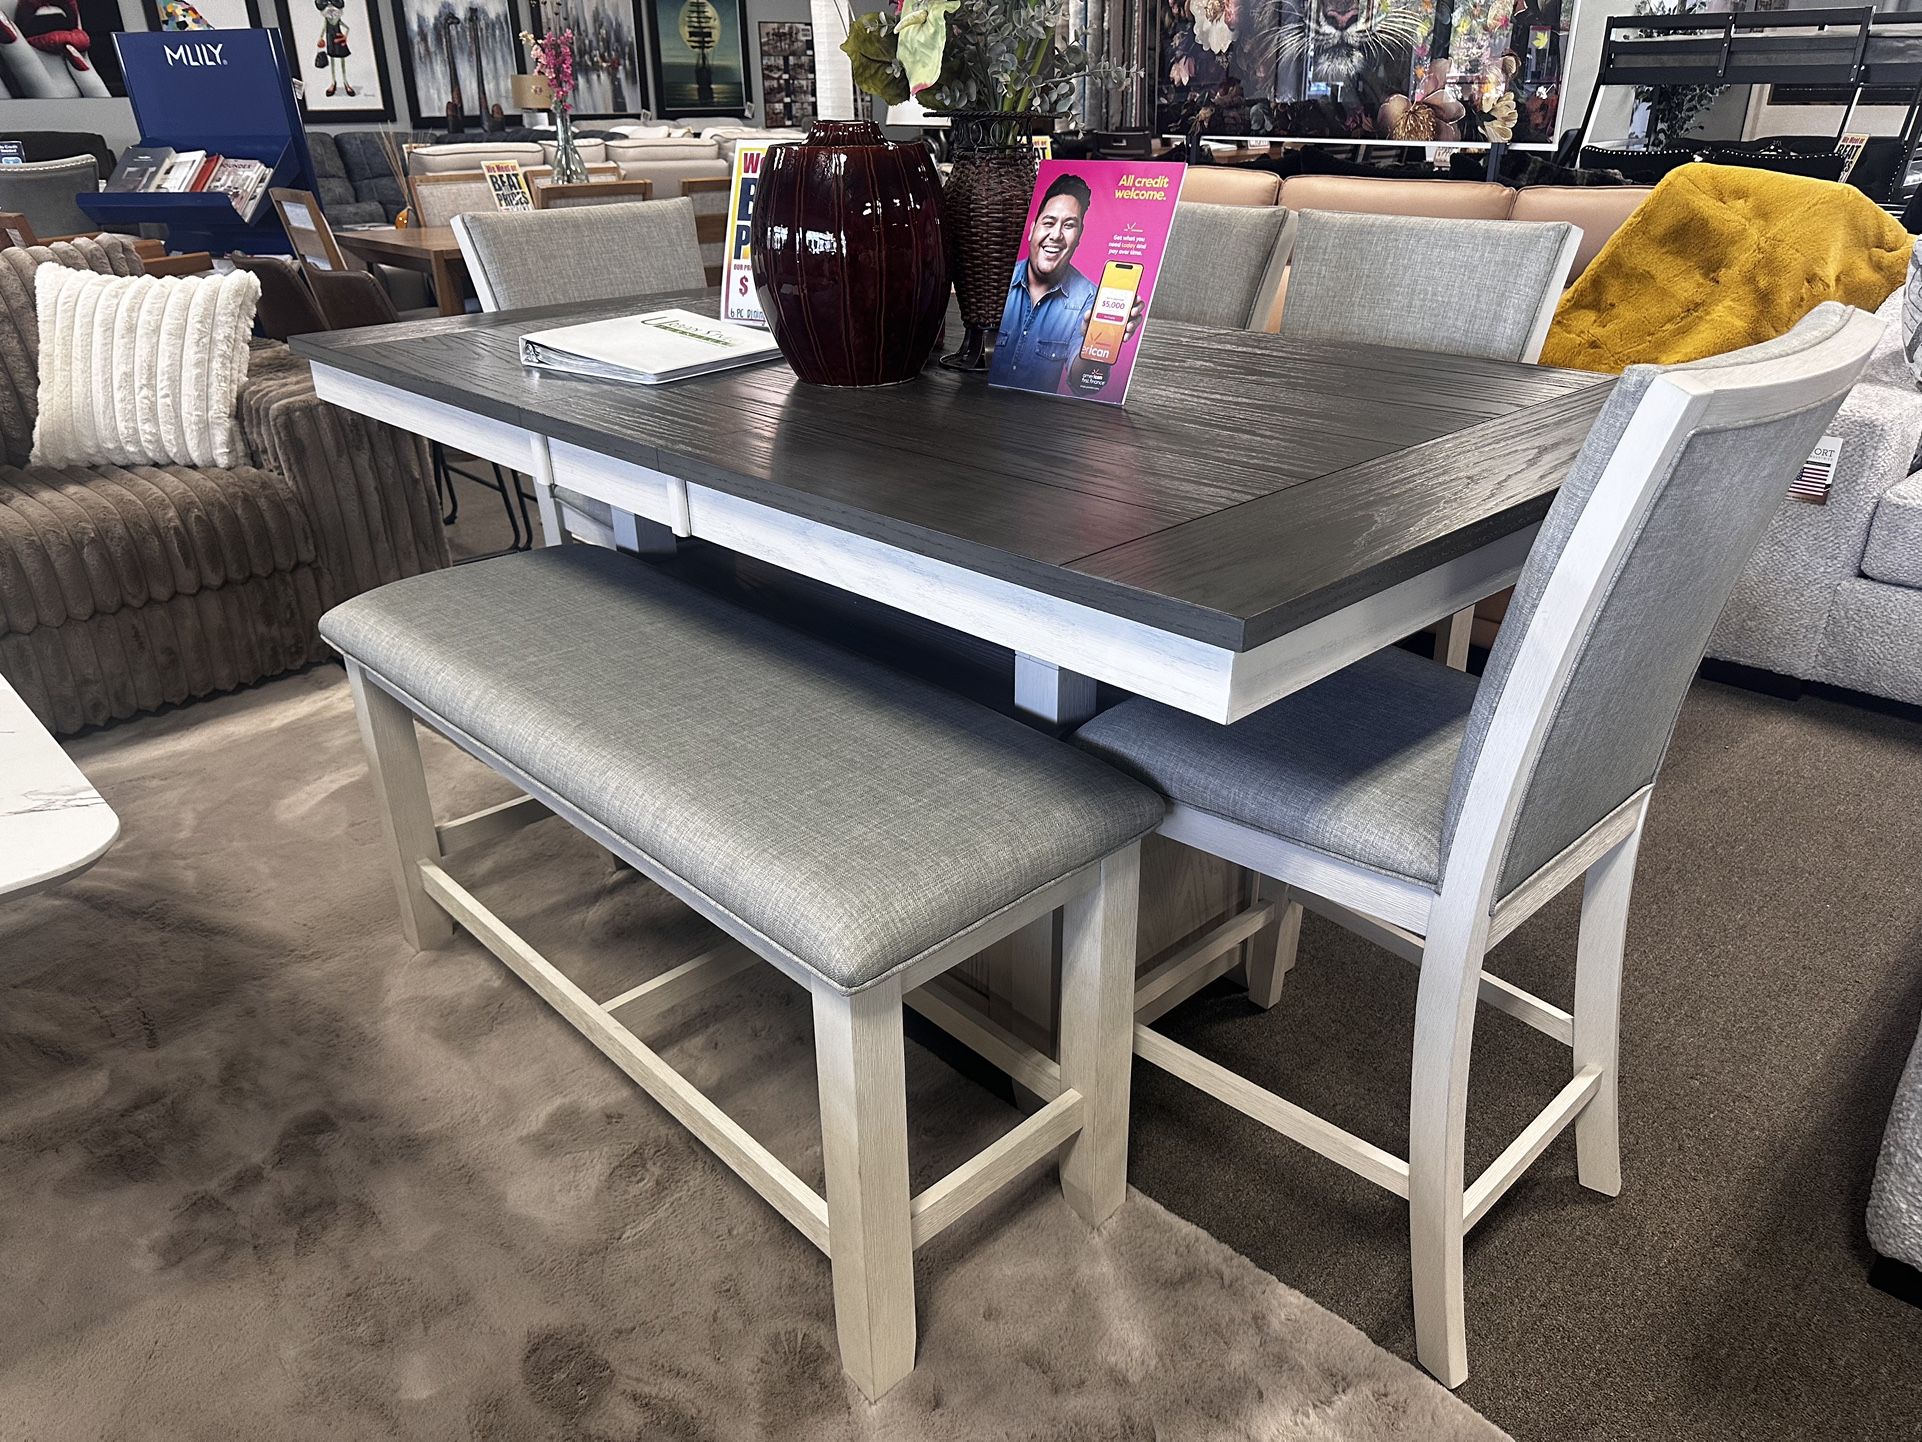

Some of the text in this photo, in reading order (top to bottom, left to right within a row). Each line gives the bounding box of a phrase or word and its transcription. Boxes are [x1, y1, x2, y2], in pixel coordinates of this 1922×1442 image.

[163, 43, 223, 66] MLILY
[743, 152, 766, 174] W
[489, 173, 522, 192] BEAT
[1118, 174, 1169, 188] All credit
[1115, 187, 1166, 201] welcome.
[739, 275, 749, 297] $
[1102, 300, 1125, 310] $5,000
[736, 308, 744, 318] PC
[1814, 447, 1836, 457] ORT
